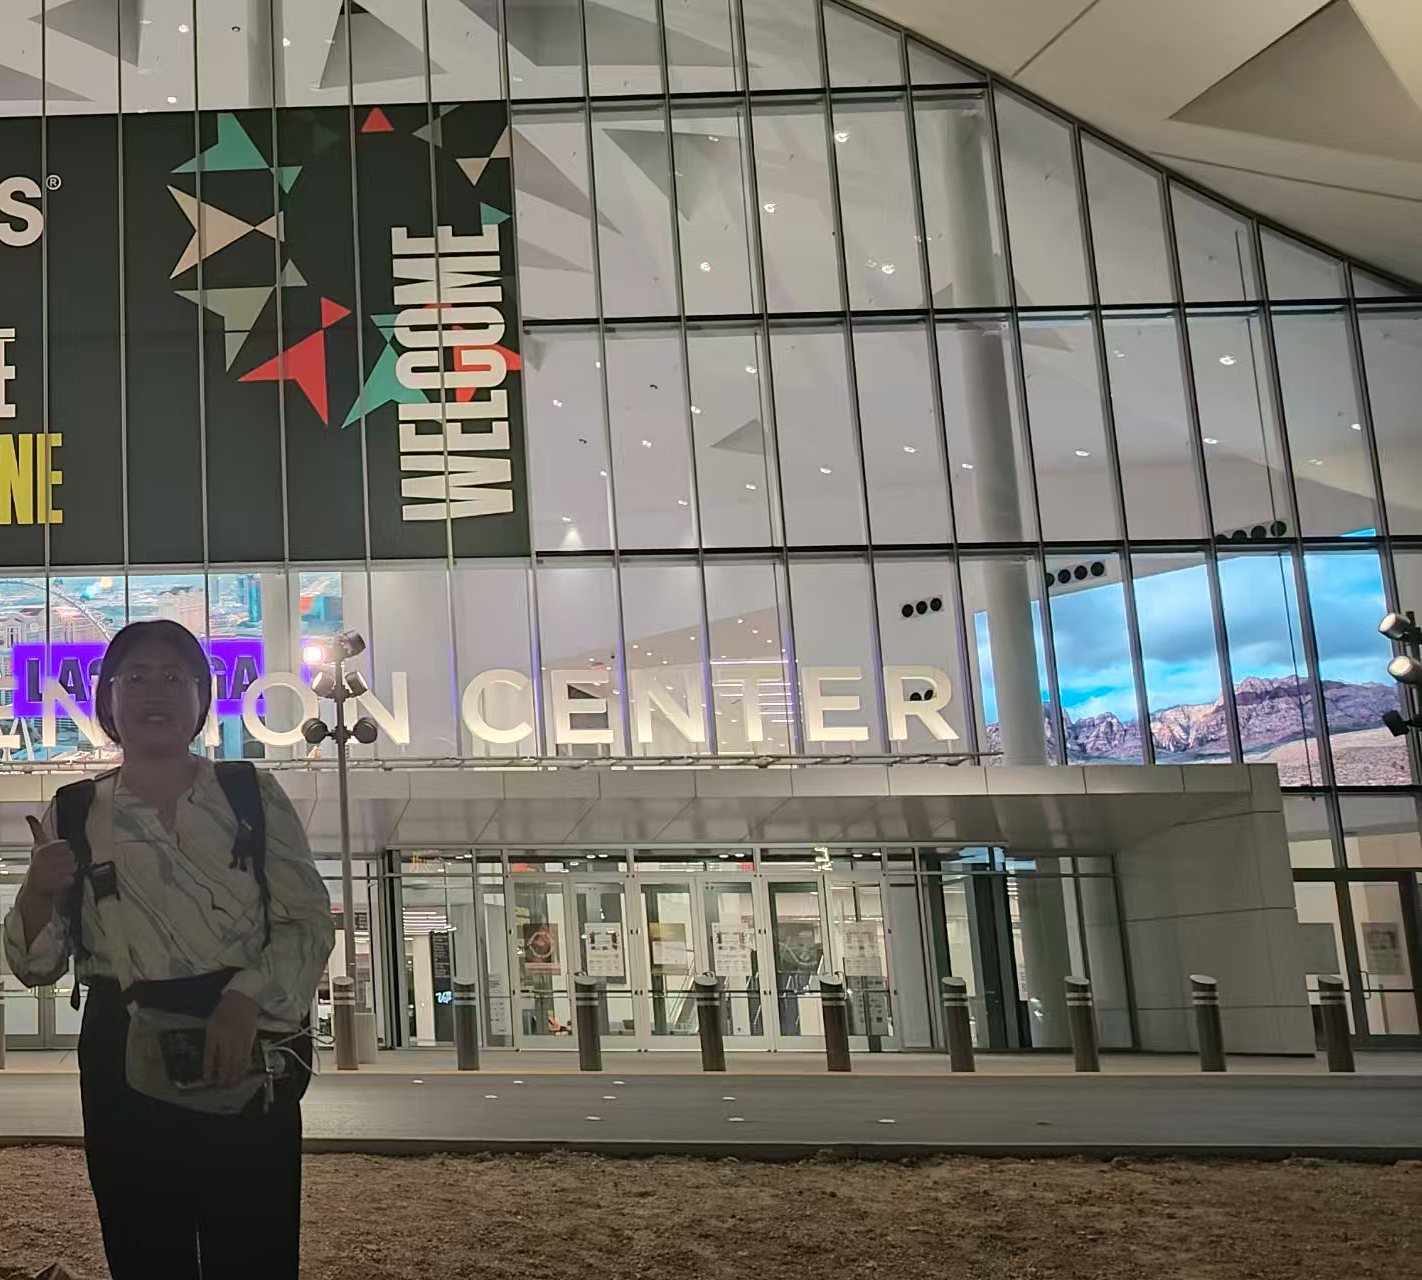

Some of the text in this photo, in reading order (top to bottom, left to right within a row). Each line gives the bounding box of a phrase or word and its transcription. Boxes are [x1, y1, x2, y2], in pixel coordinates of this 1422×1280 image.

[391, 224, 514, 521] WELCOME
[26, 656, 104, 703] LA
[460, 665, 961, 745] CENTER
